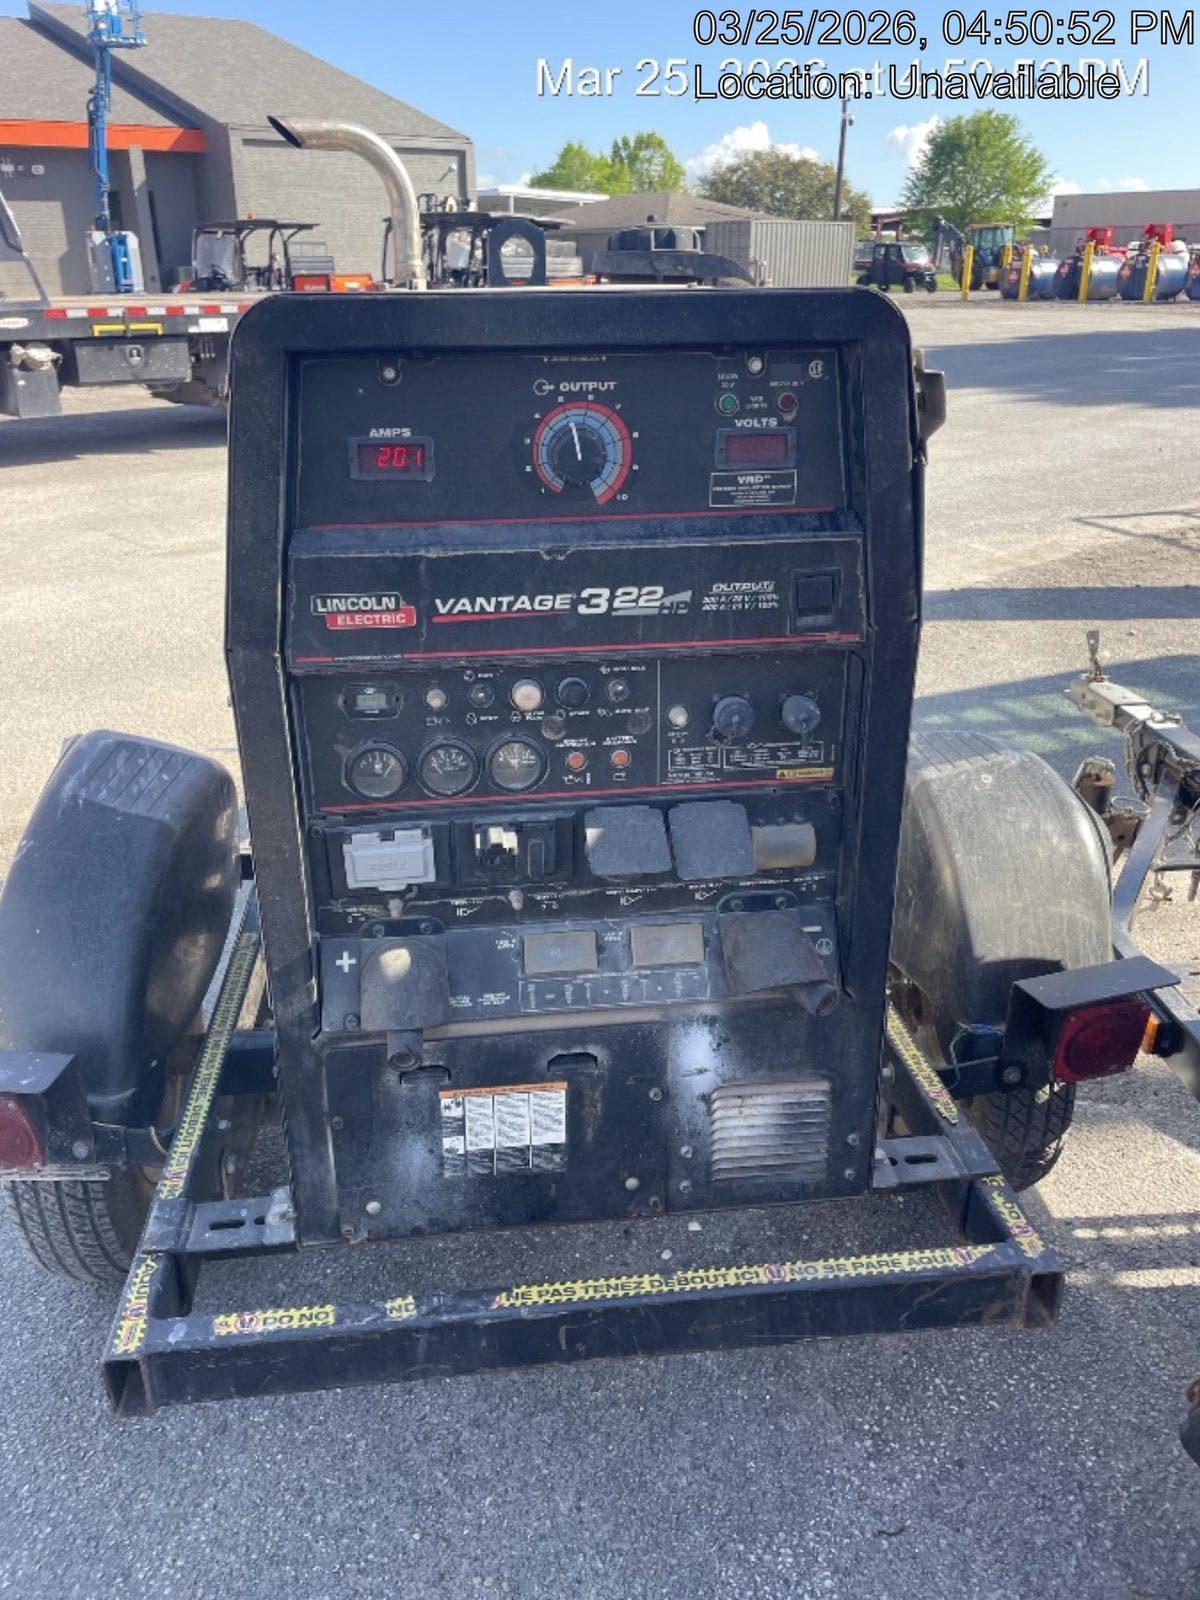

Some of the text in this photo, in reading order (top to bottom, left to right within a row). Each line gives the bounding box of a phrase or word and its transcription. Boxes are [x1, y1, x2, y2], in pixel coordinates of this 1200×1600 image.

[559, 381, 617, 392] OUTPUT
[734, 417, 778, 428] VOLTS
[369, 428, 412, 438] AMPS
[377, 447, 423, 467] 201
[315, 597, 396, 612] LINCOLN
[434, 594, 573, 614] VANTAGE
[577, 586, 664, 615] 322
[336, 613, 406, 626] ELECTRIC
[789, 1265, 818, 1277] NO
[852, 1259, 902, 1271] PARE
[908, 1254, 953, 1266] AQUI
[537, 1287, 577, 1298] PAS
[582, 1280, 644, 1294] TENEZ
[649, 1272, 729, 1288] DEBOUT
[735, 1270, 760, 1281] ICI
